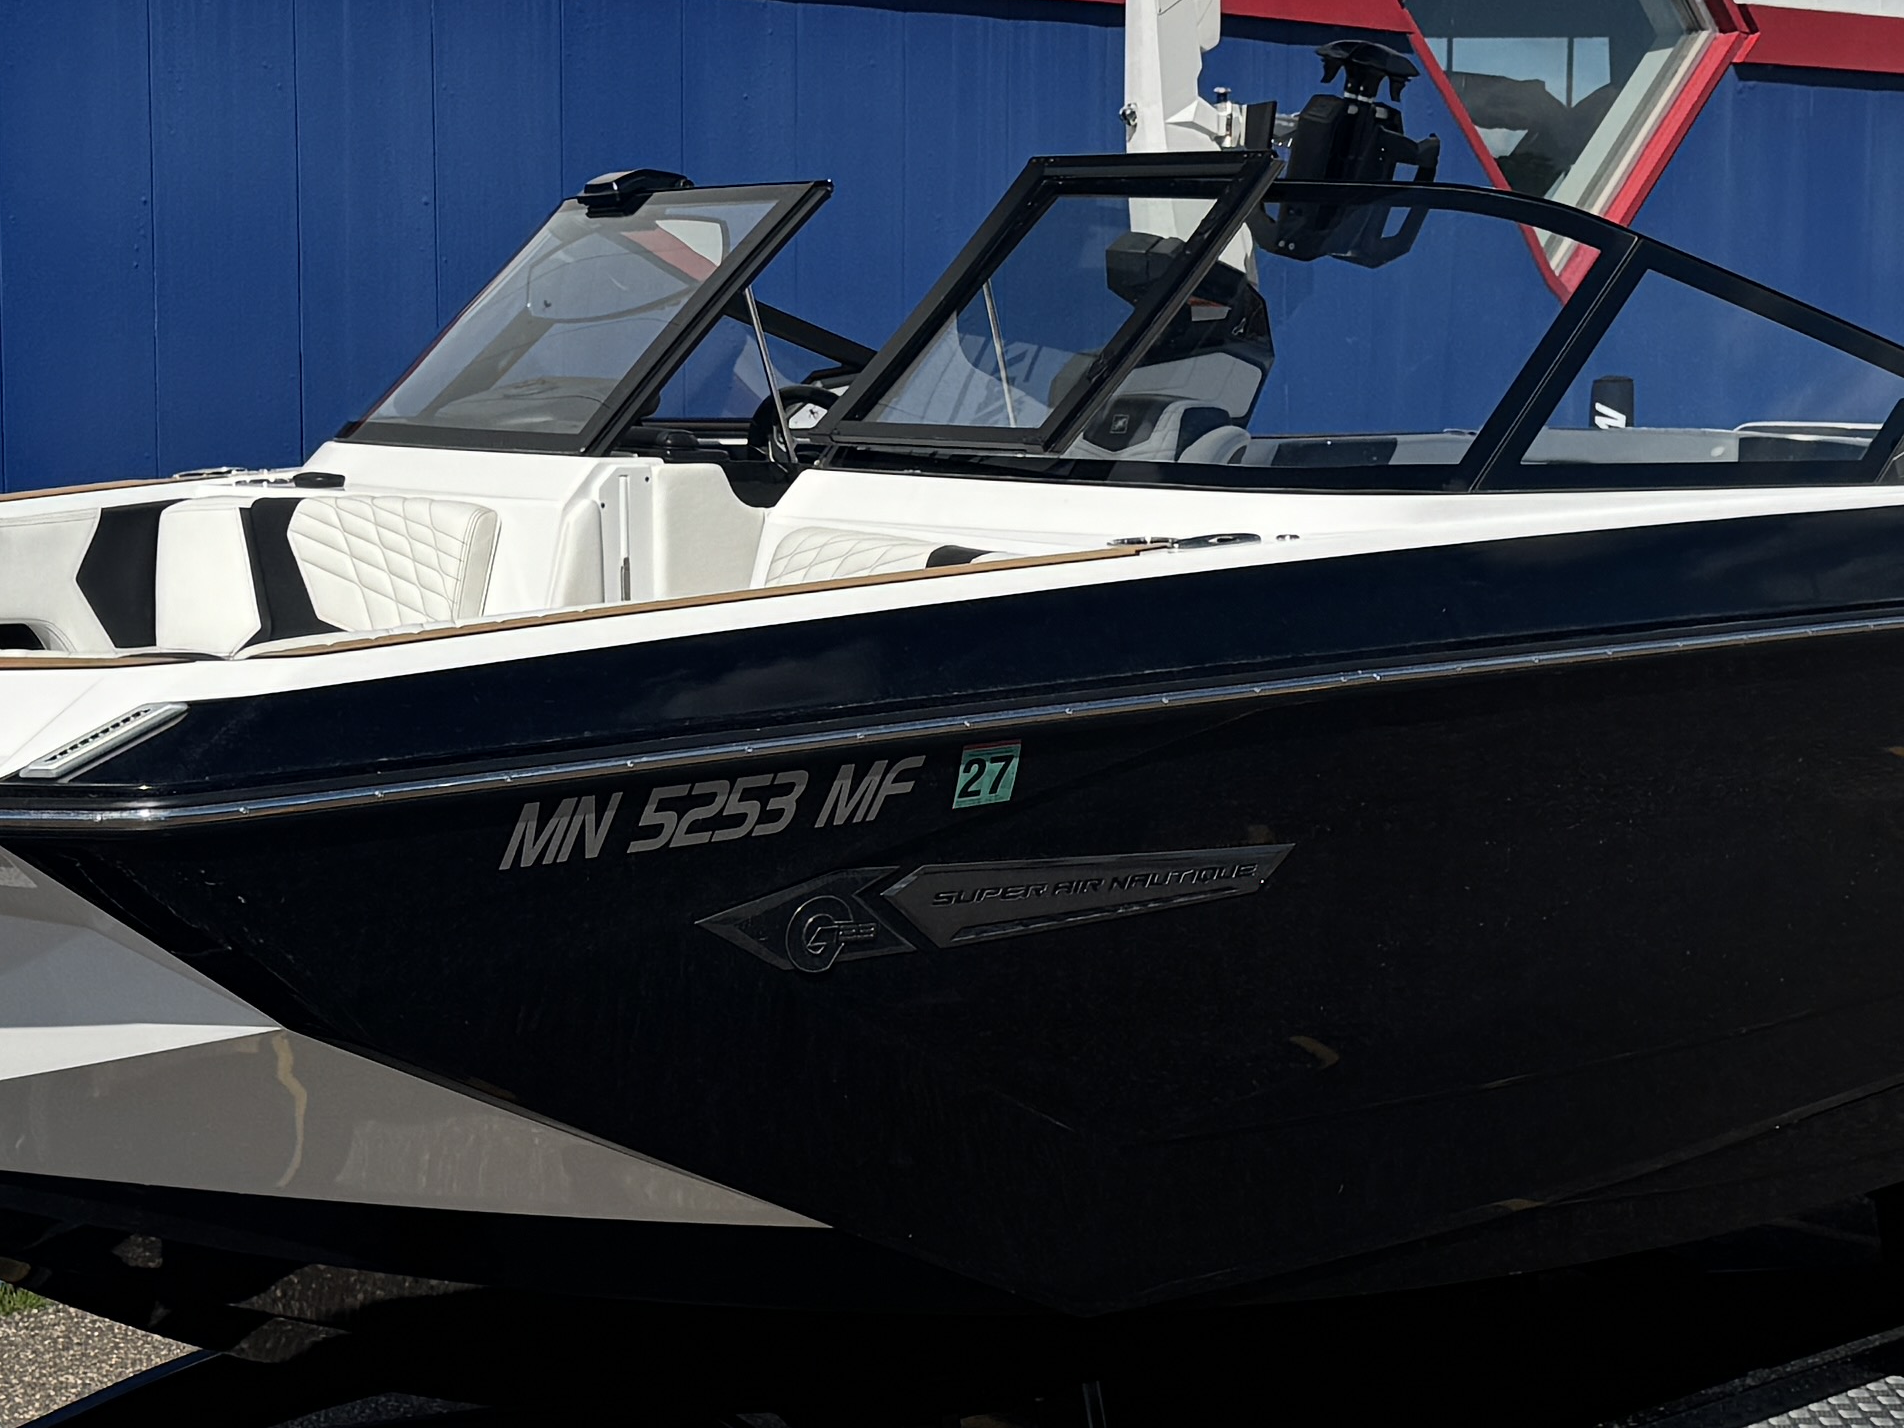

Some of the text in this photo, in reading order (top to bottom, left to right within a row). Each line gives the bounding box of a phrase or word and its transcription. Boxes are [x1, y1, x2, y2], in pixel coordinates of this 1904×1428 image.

[957, 754, 1015, 799] 27
[498, 754, 926, 871] MN 5253 MF
[930, 863, 1258, 907] SUPER AIR NAUTIQUE
